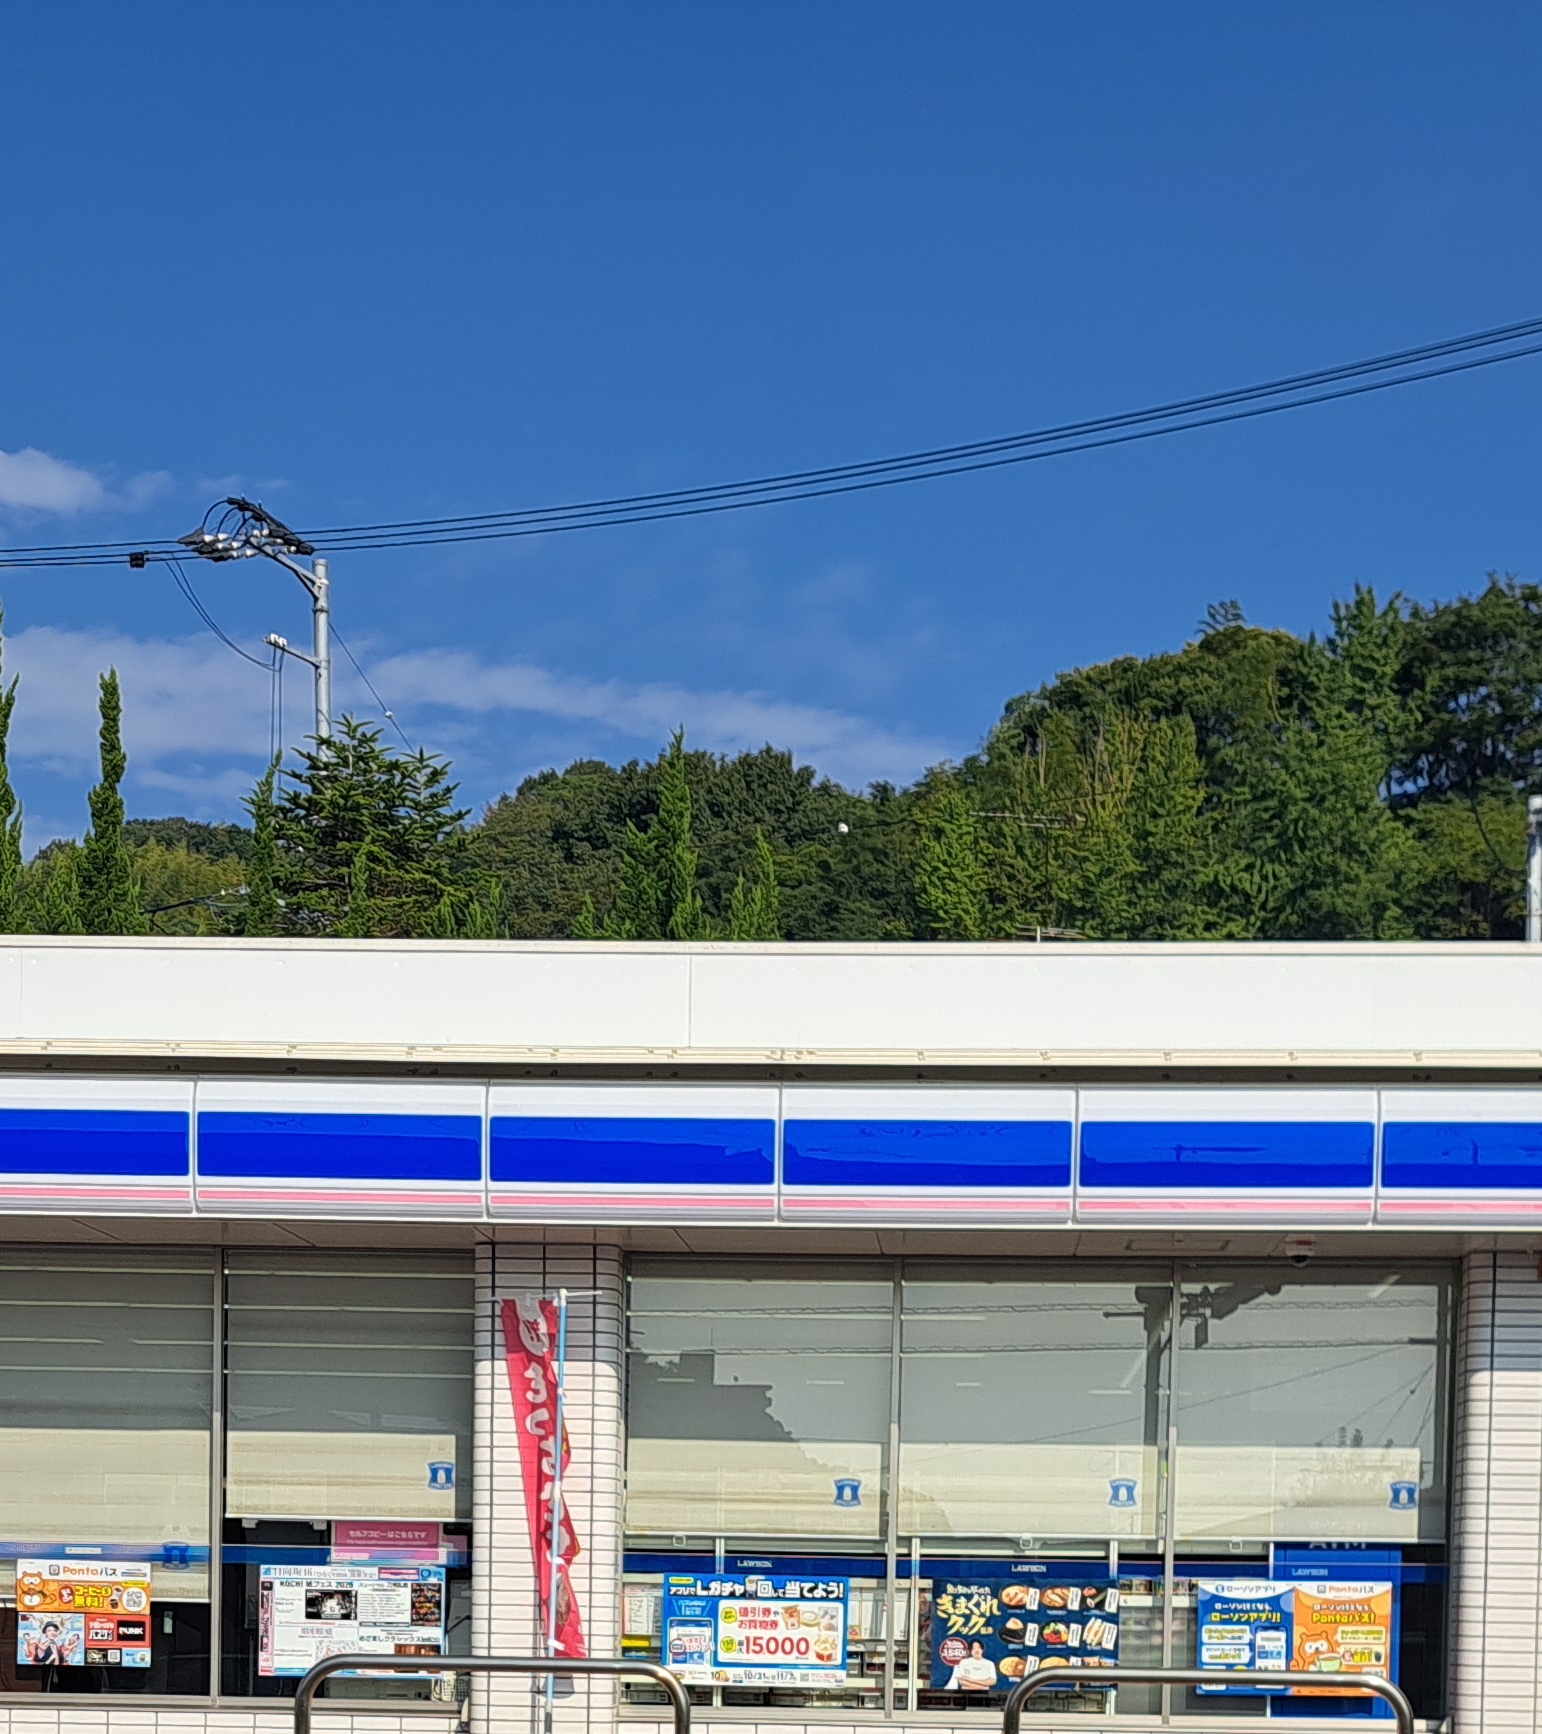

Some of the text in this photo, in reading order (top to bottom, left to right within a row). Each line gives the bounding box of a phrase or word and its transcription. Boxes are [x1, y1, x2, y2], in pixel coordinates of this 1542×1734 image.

[63, 1566, 118, 1577] Pontaパス
[935, 1593, 1002, 1618] きまぐれ
[1311, 1613, 1376, 1625] Pontaパス!
